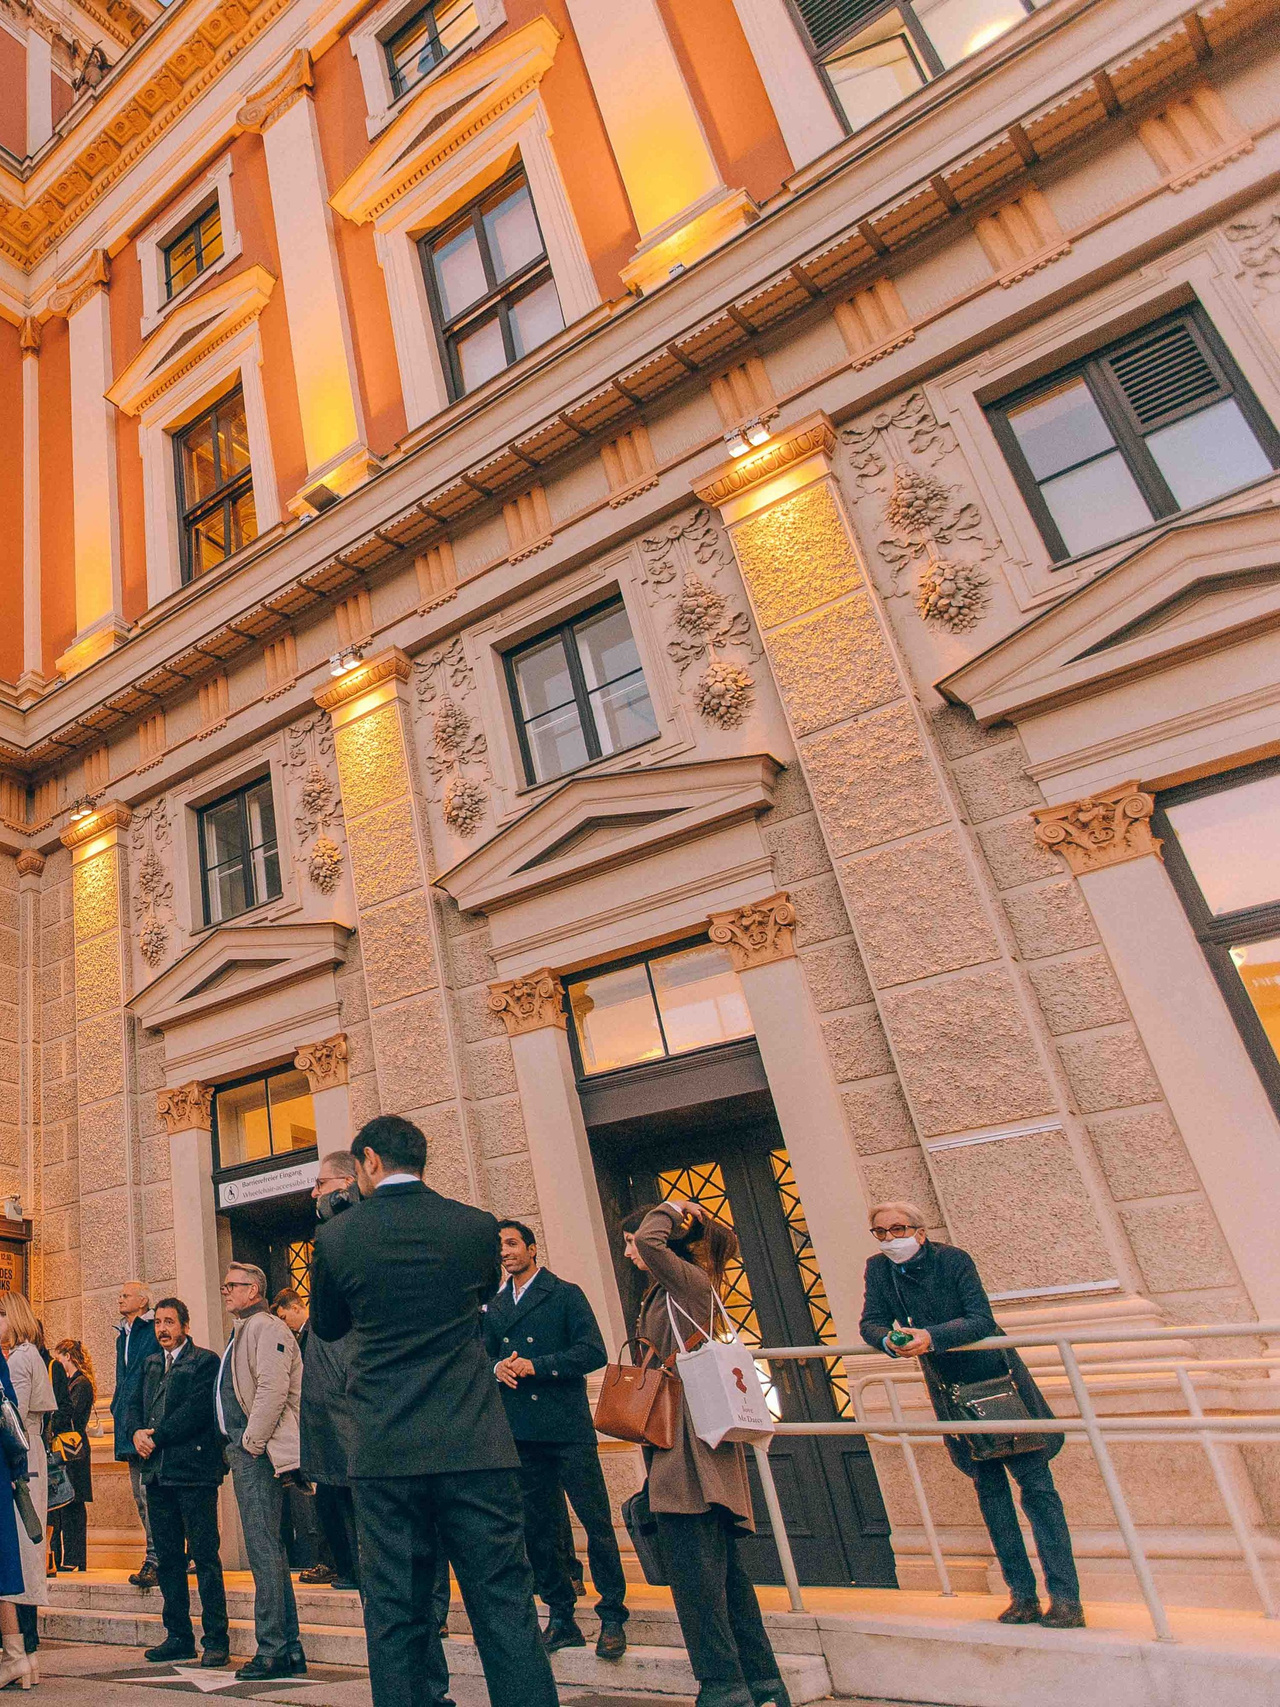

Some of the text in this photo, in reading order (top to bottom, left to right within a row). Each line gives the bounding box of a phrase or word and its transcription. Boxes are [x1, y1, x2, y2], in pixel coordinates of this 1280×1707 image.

[242, 1169, 303, 1188] Barrierefreier Eingang
[0, 1267, 13, 1280] DES
[742, 1405, 753, 1413] love
[747, 1415, 763, 1425] Darcy
